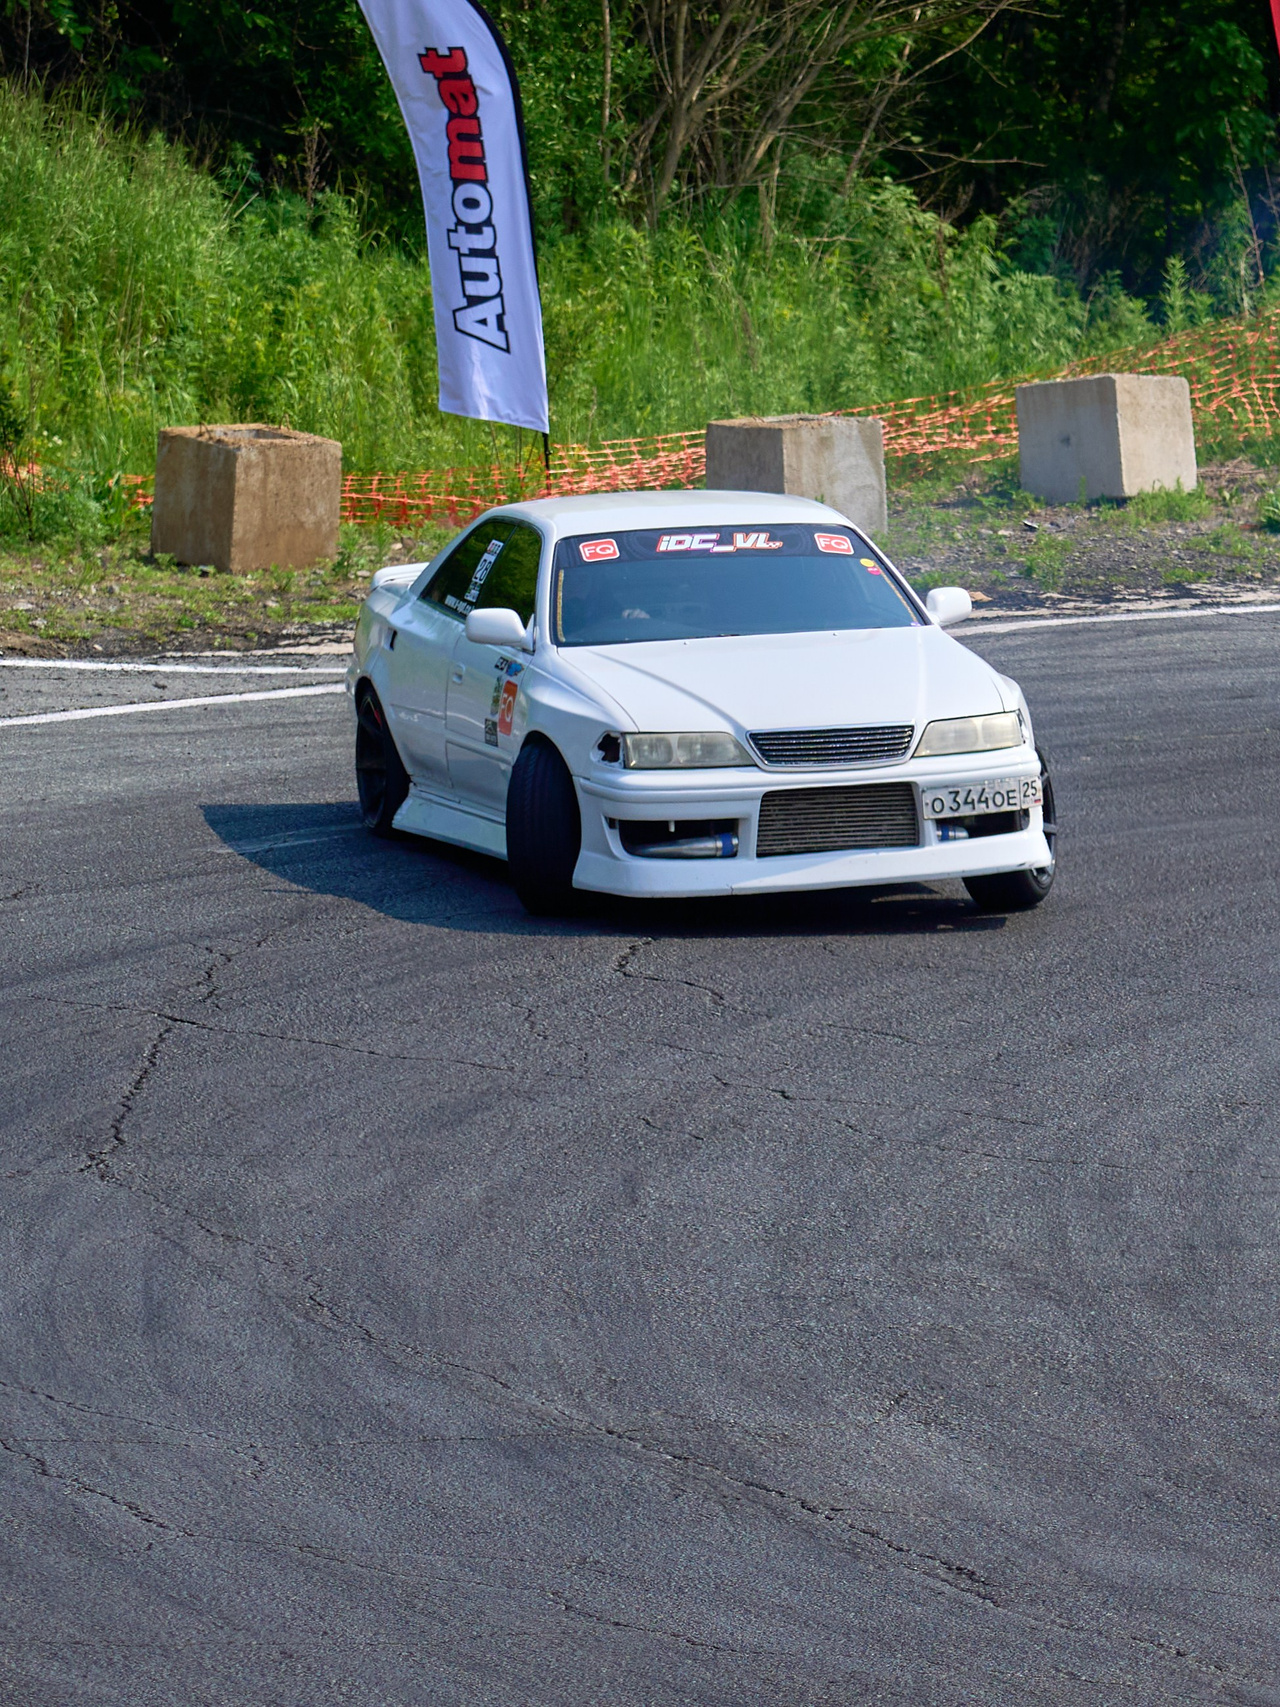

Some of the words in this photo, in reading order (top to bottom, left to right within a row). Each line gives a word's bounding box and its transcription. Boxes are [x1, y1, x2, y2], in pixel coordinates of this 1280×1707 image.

[417, 46, 511, 354] Automat
[584, 545, 614, 557] FQ
[819, 536, 849, 550] FQ
[1022, 780, 1037, 798] 25
